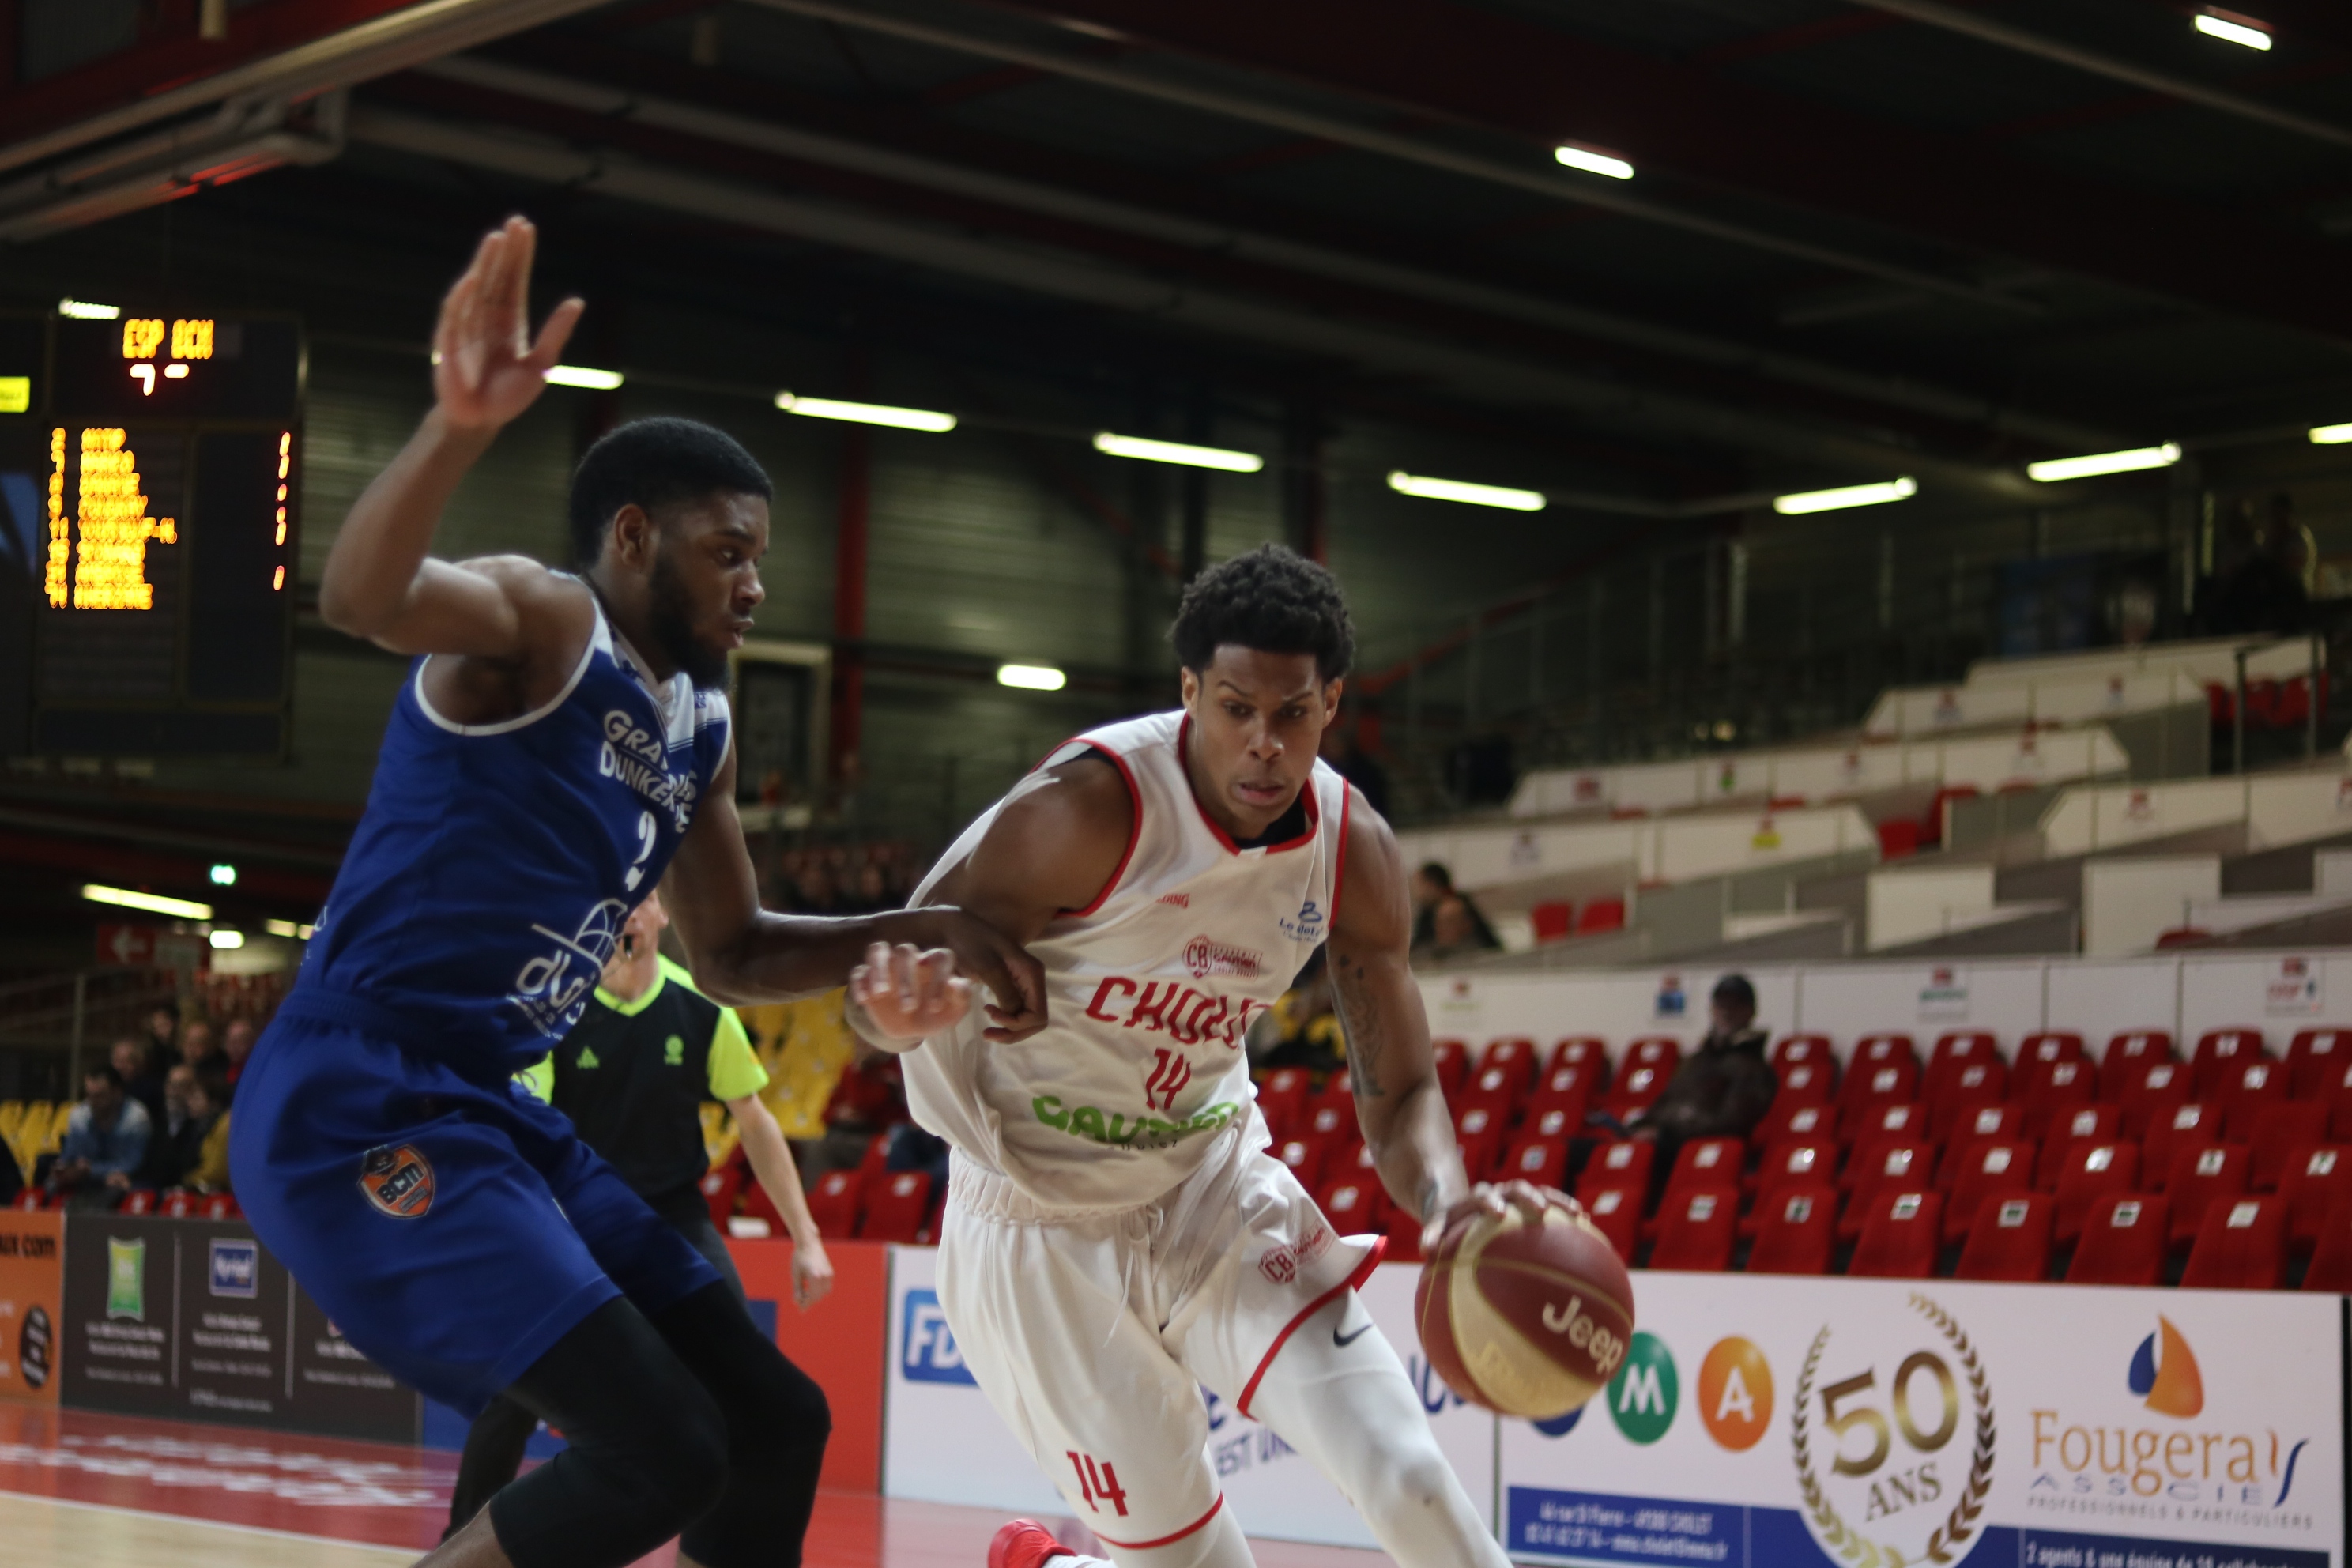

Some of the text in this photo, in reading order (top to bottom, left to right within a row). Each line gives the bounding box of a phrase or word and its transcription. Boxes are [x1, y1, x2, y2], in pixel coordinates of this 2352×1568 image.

[1186, 944, 1209, 969] CB
[1085, 977, 1272, 1050] CHOL
[1146, 1048, 1191, 1111] 14
[375, 1163, 424, 1206] BCM
[906, 1305, 973, 1370] FD
[1542, 1295, 1624, 1375] Jeep
[1819, 1351, 1958, 1477] 50
[1066, 1450, 1129, 1517] 14
[1865, 1461, 1943, 1521] ANS
